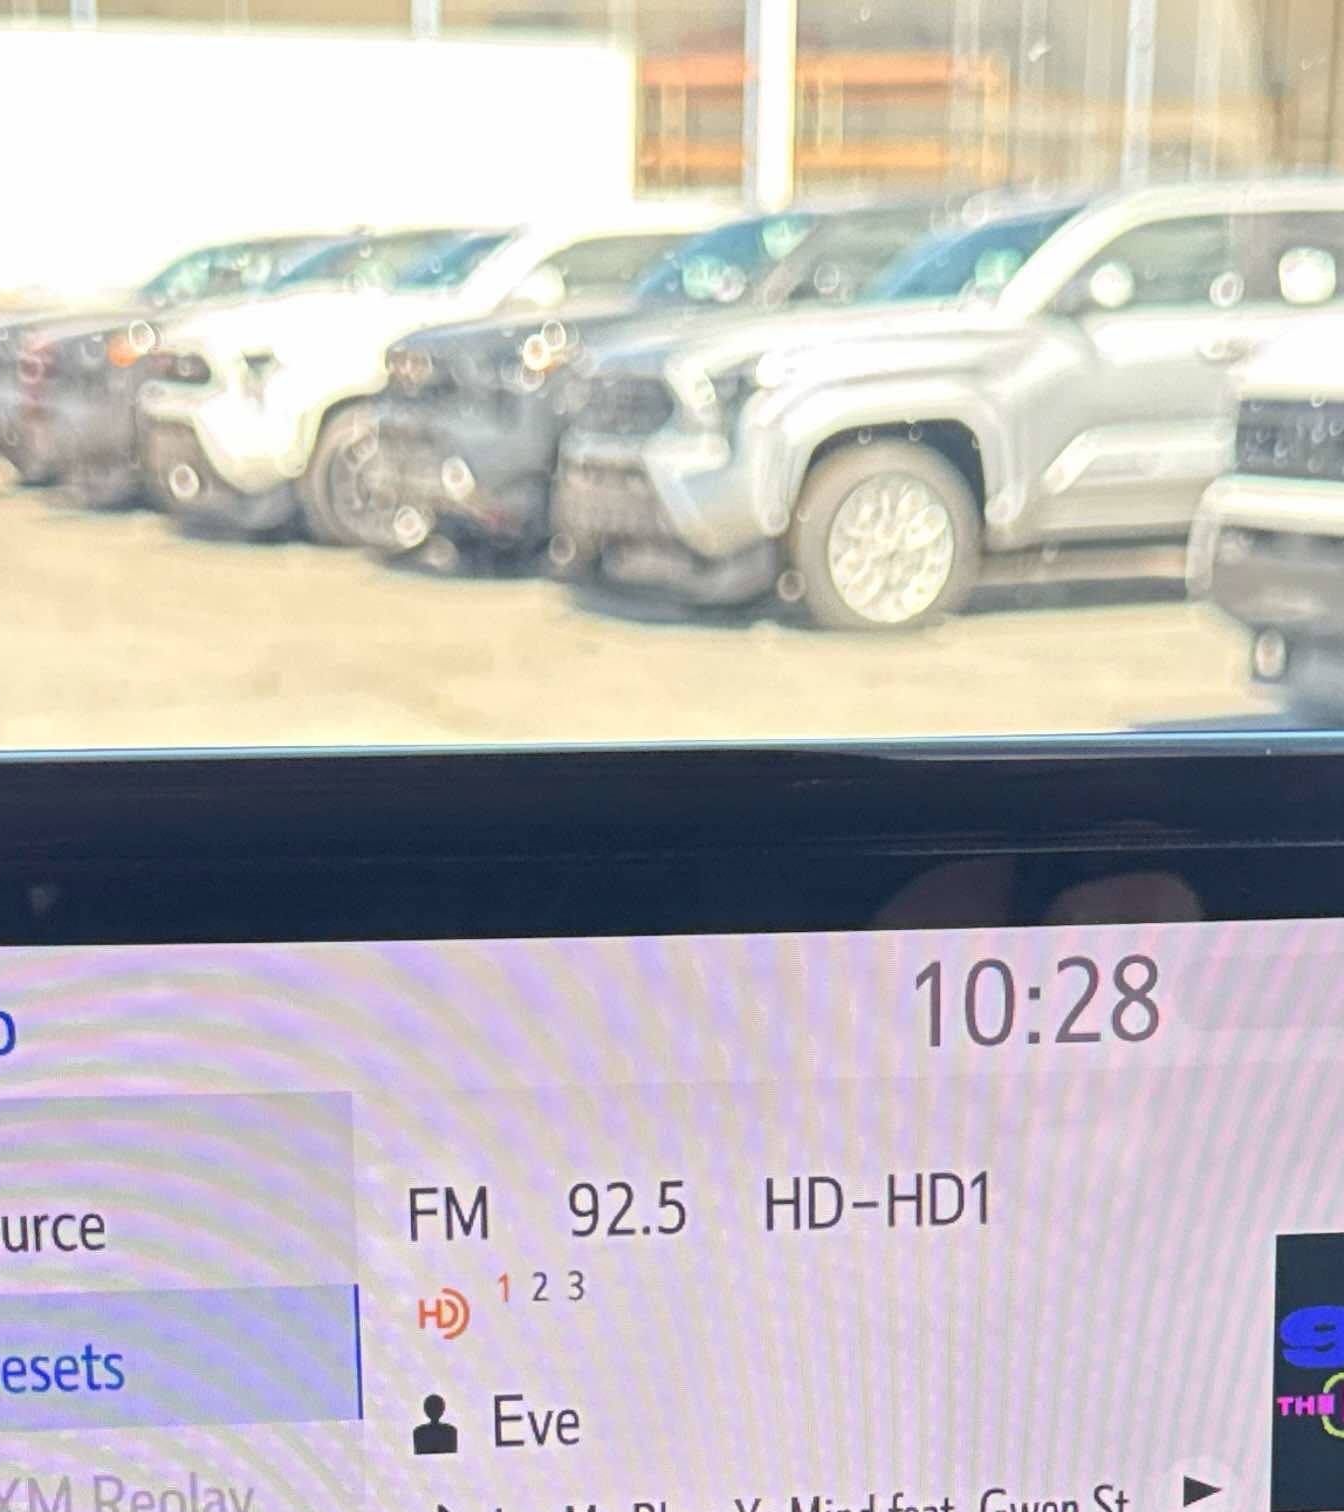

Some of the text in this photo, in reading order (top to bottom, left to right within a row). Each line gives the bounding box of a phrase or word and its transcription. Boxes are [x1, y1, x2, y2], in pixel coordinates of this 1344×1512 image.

[913, 955, 1161, 1048] 10:28
[408, 1170, 990, 1241] FM 92.5 HD-HD1
[532, 1271, 550, 1301] 2
[567, 1269, 586, 1300] 3
[493, 1393, 582, 1448] Eve
